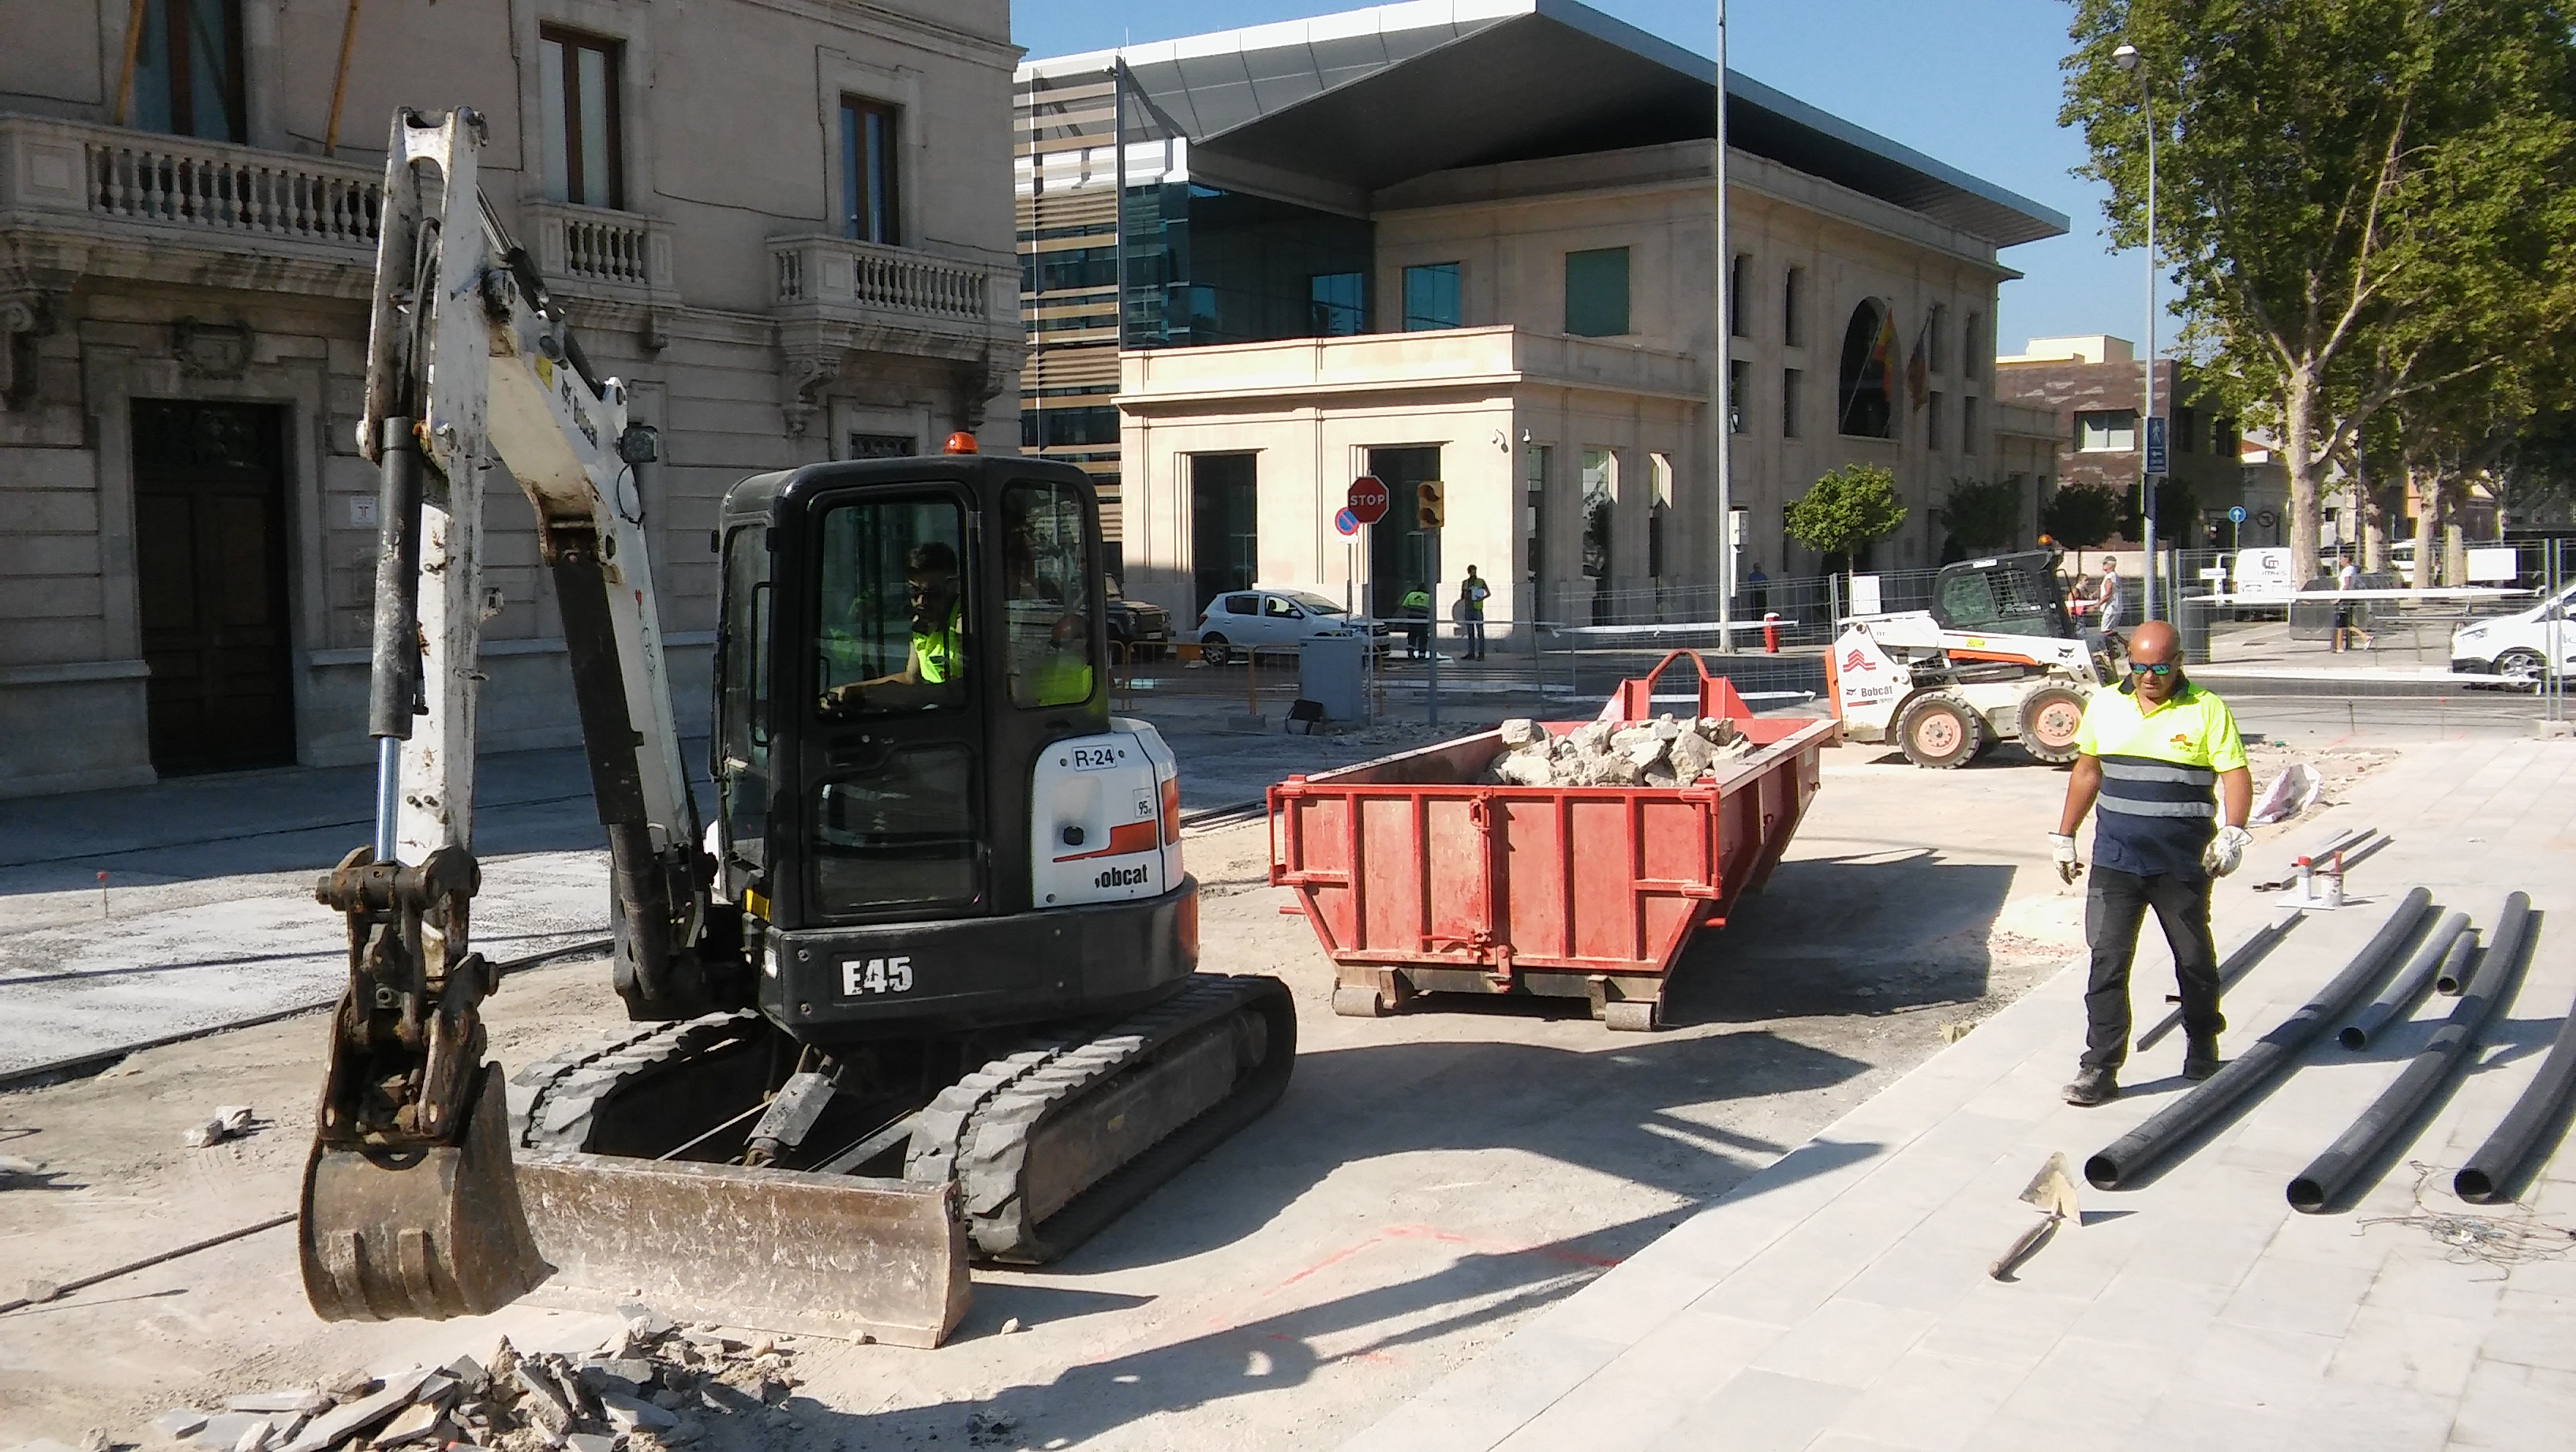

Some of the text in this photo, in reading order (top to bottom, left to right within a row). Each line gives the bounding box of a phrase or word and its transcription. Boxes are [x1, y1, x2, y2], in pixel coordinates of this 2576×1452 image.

[1350, 493, 1386, 507] STOP
[1860, 685, 1893, 698] Bobcat
[1075, 748, 1114, 767] R-24
[1138, 800, 1148, 815] 95
[1095, 864, 1148, 889] obcat
[841, 956, 914, 996] E45
